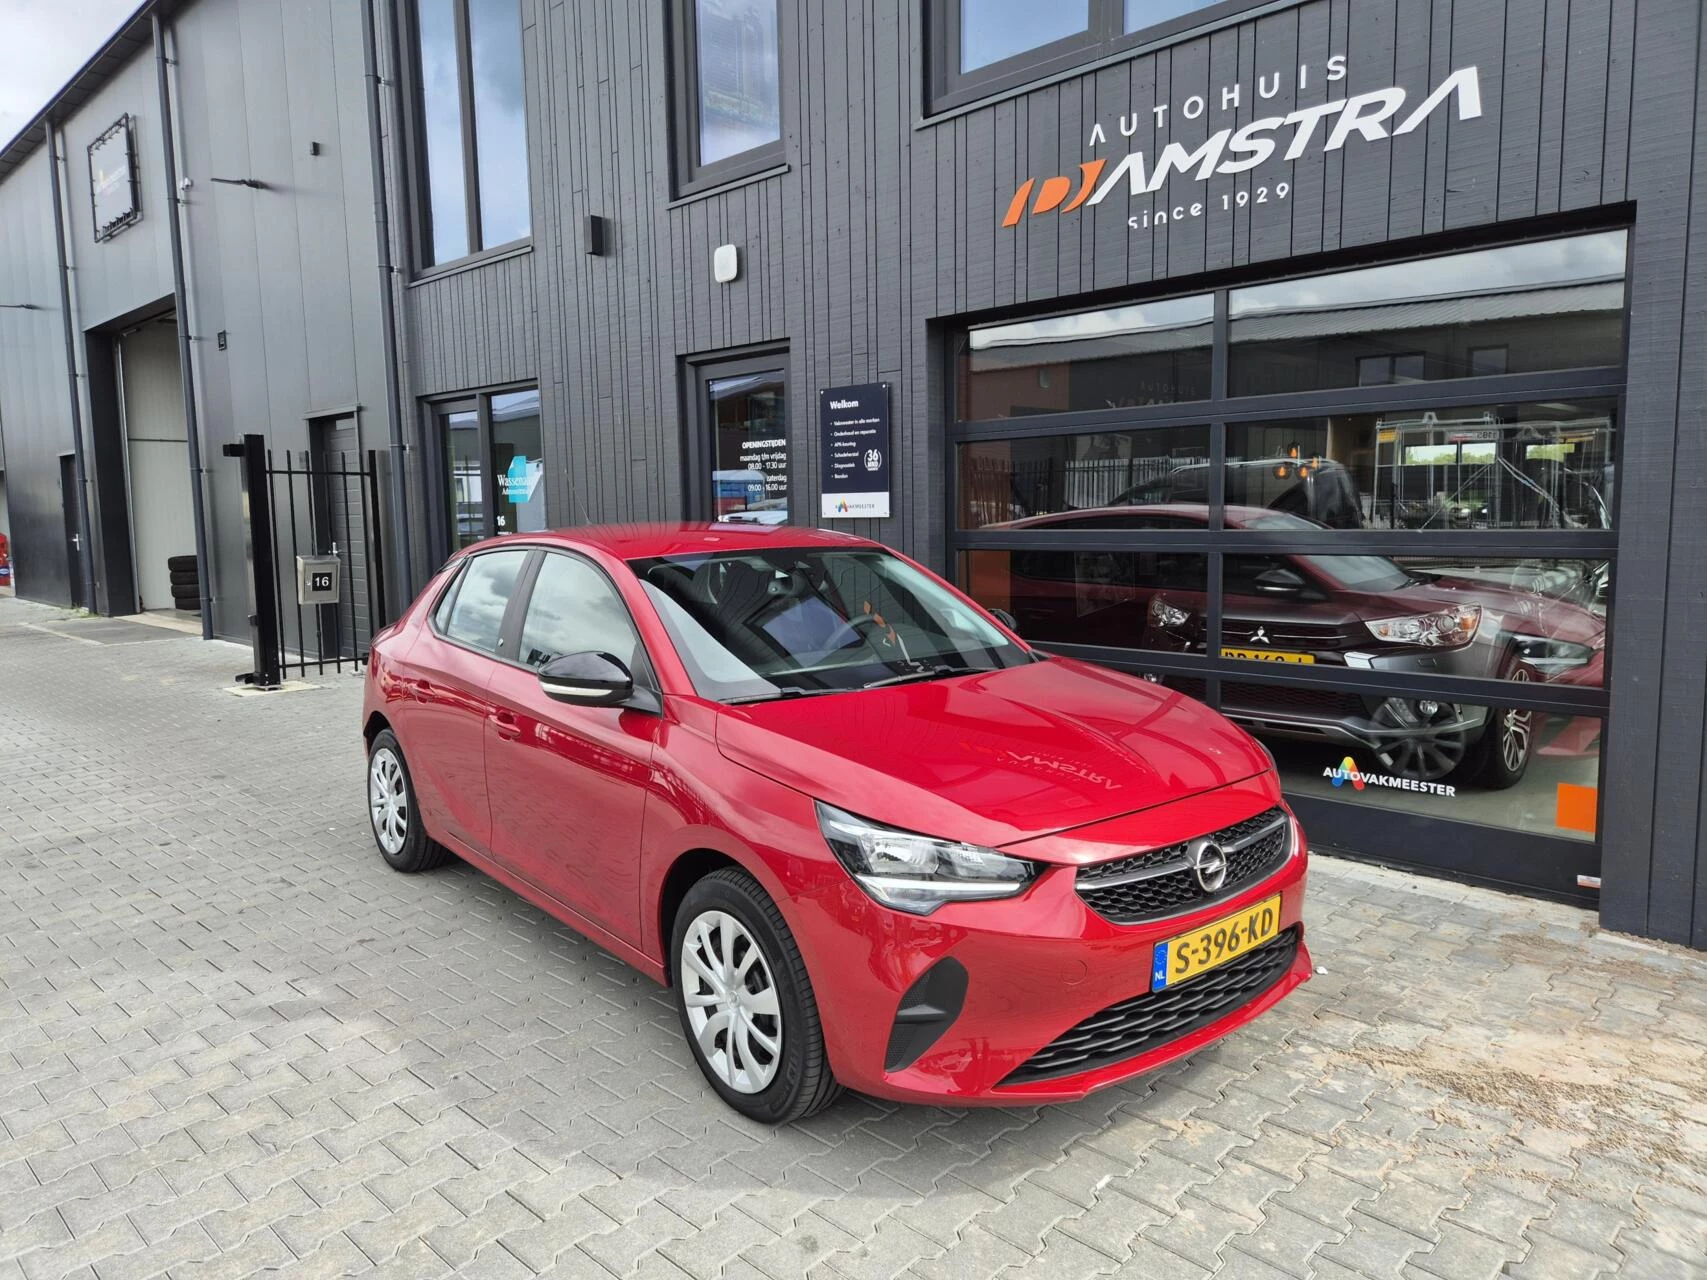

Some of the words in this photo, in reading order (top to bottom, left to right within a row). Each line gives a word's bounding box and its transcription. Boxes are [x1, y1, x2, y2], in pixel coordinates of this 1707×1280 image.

[1089, 55, 1347, 147] AUTOHUIS
[1127, 202, 1203, 230] since
[1221, 182, 1291, 211] 1929
[830, 400, 859, 410] Welkom
[742, 438, 786, 449] OPENINGSTIJDEN
[739, 453, 761, 462] maandag
[770, 451, 787, 461] vrijdag
[867, 449, 879, 461] 36
[766, 473, 787, 483] zaterdag
[496, 515, 506, 527] 16
[315, 576, 329, 587] 16
[1322, 766, 1456, 798] AUTOVAKMEESTER
[1175, 907, 1274, 974] S-396-KD
[1154, 970, 1165, 982] NL
